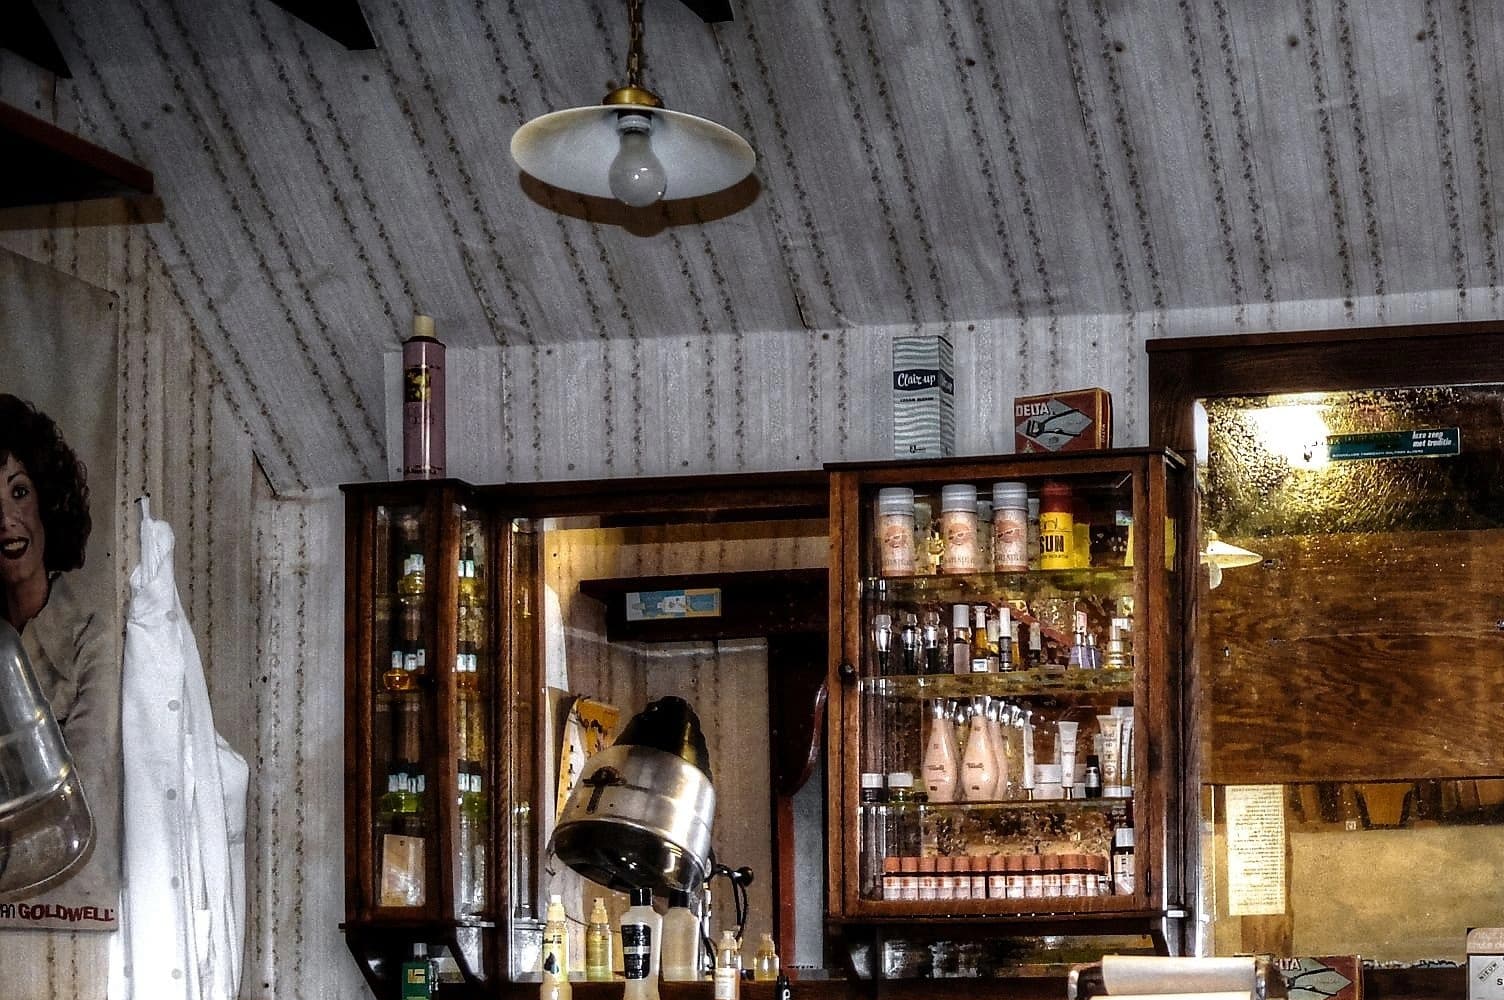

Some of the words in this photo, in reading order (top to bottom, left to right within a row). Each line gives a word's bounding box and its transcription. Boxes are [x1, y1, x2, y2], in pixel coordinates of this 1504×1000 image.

[1015, 403, 1049, 417] DELTA
[0, 903, 16, 919] AN
[17, 903, 115, 922] GOLDWELL
[1273, 957, 1301, 971] ELTA
